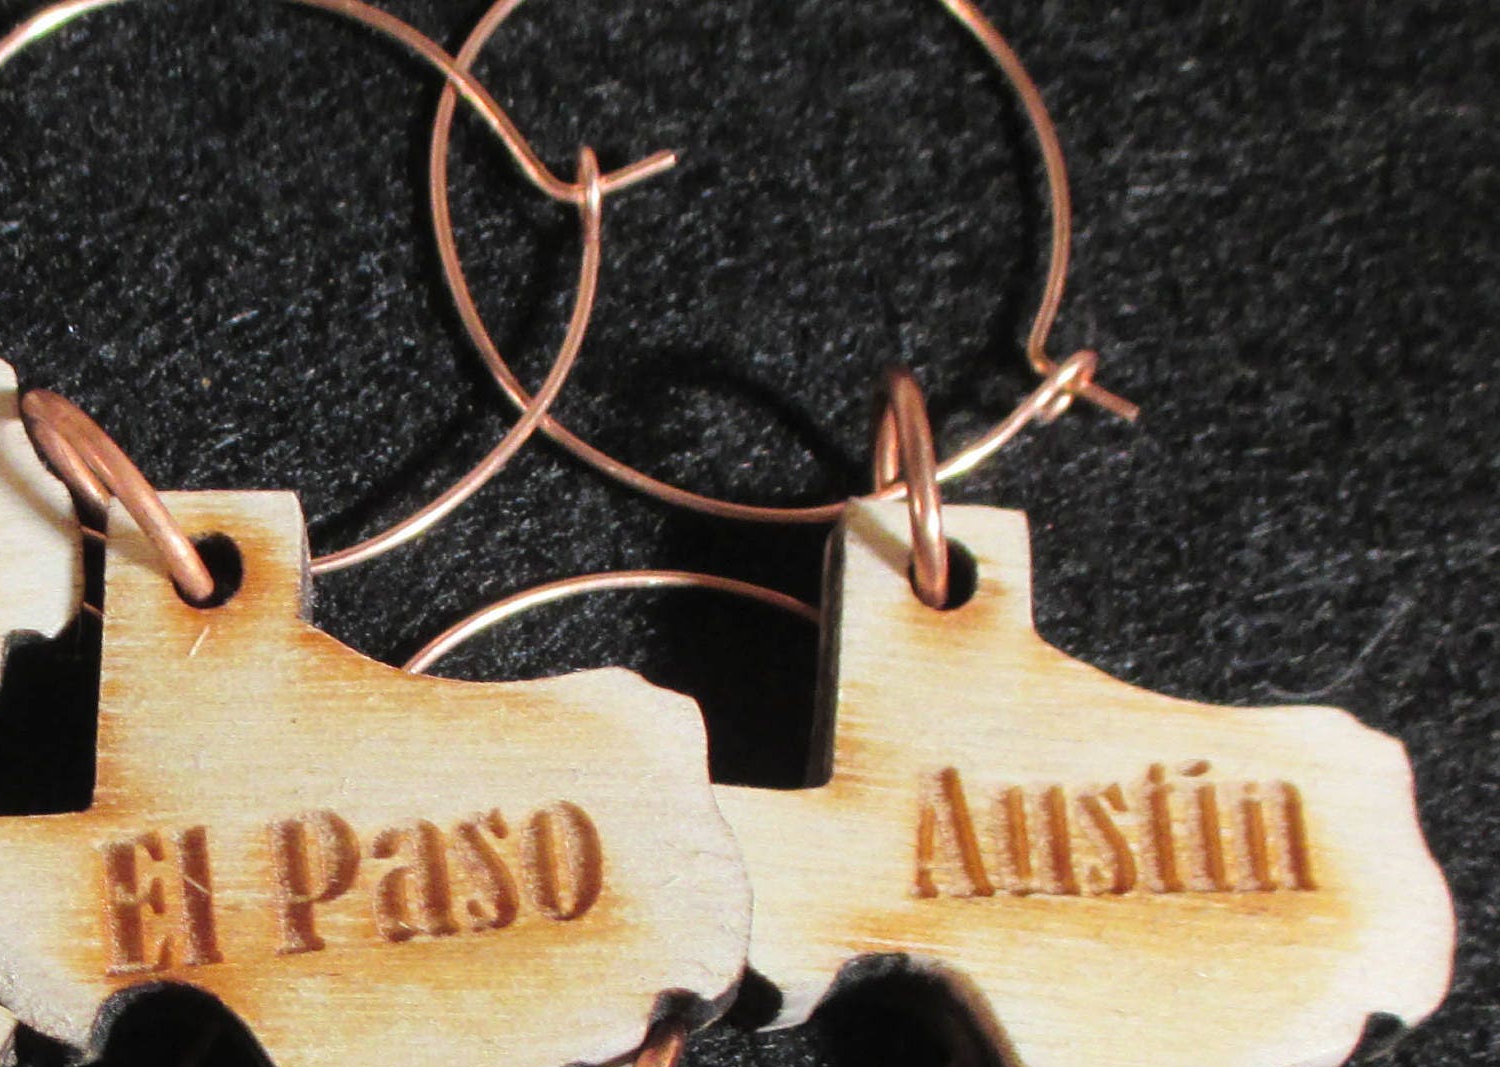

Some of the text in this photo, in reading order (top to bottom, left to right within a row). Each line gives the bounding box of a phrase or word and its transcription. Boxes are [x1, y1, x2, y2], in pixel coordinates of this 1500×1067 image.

[102, 800, 603, 975] El Paso
[909, 760, 1318, 897] Austin
